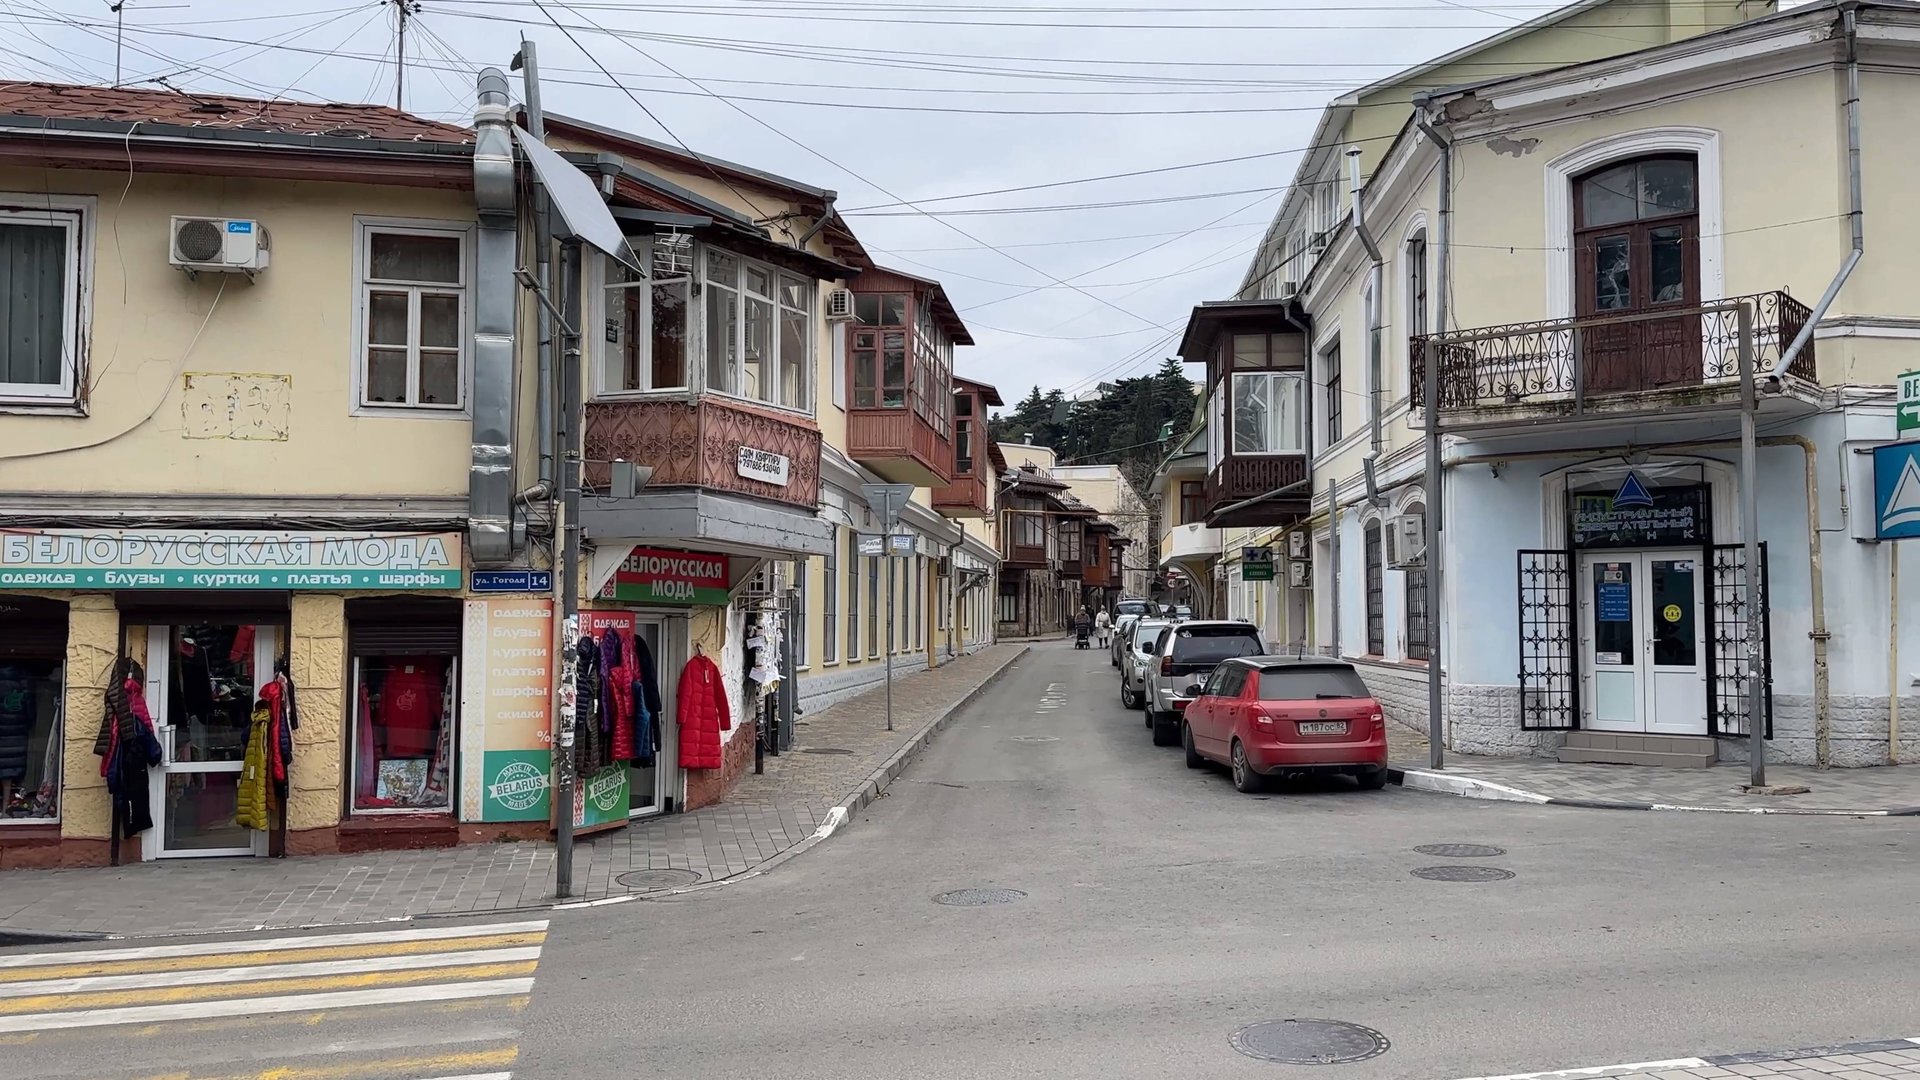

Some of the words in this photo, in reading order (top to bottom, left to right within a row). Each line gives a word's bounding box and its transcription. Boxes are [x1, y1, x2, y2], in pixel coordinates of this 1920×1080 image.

[1575, 506, 1693, 522] ИНДУСТРИАЛЬНЫЙ
[1575, 517, 1694, 532] СБЕРЕГАТЕЛЬНЫЙ
[2, 534, 311, 566] БЕЛОРУССКАЯ
[321, 537, 449, 570] МОДА
[620, 556, 722, 578] БЕЛОРУССКАЯ
[1, 573, 76, 584] одежда
[105, 571, 165, 586] блузы
[193, 574, 260, 587] куртки
[287, 573, 351, 584] платья
[379, 572, 445, 587] шарфы
[492, 576, 525, 584] Гоголя
[531, 576, 548, 586] 14
[651, 580, 695, 600] МОДА
[493, 609, 552, 618] одежда
[493, 626, 541, 639] блузы
[493, 648, 547, 659] куртки
[492, 667, 545, 677] платья
[492, 685, 548, 698] шарфы
[497, 710, 544, 719] скидки
[502, 764, 523, 778] MADE
[523, 763, 532, 772] IN
[496, 778, 543, 796] BELARUS
[593, 772, 623, 795] BELARUS
[507, 799, 528, 809] MADE
[528, 795, 537, 804] IN
